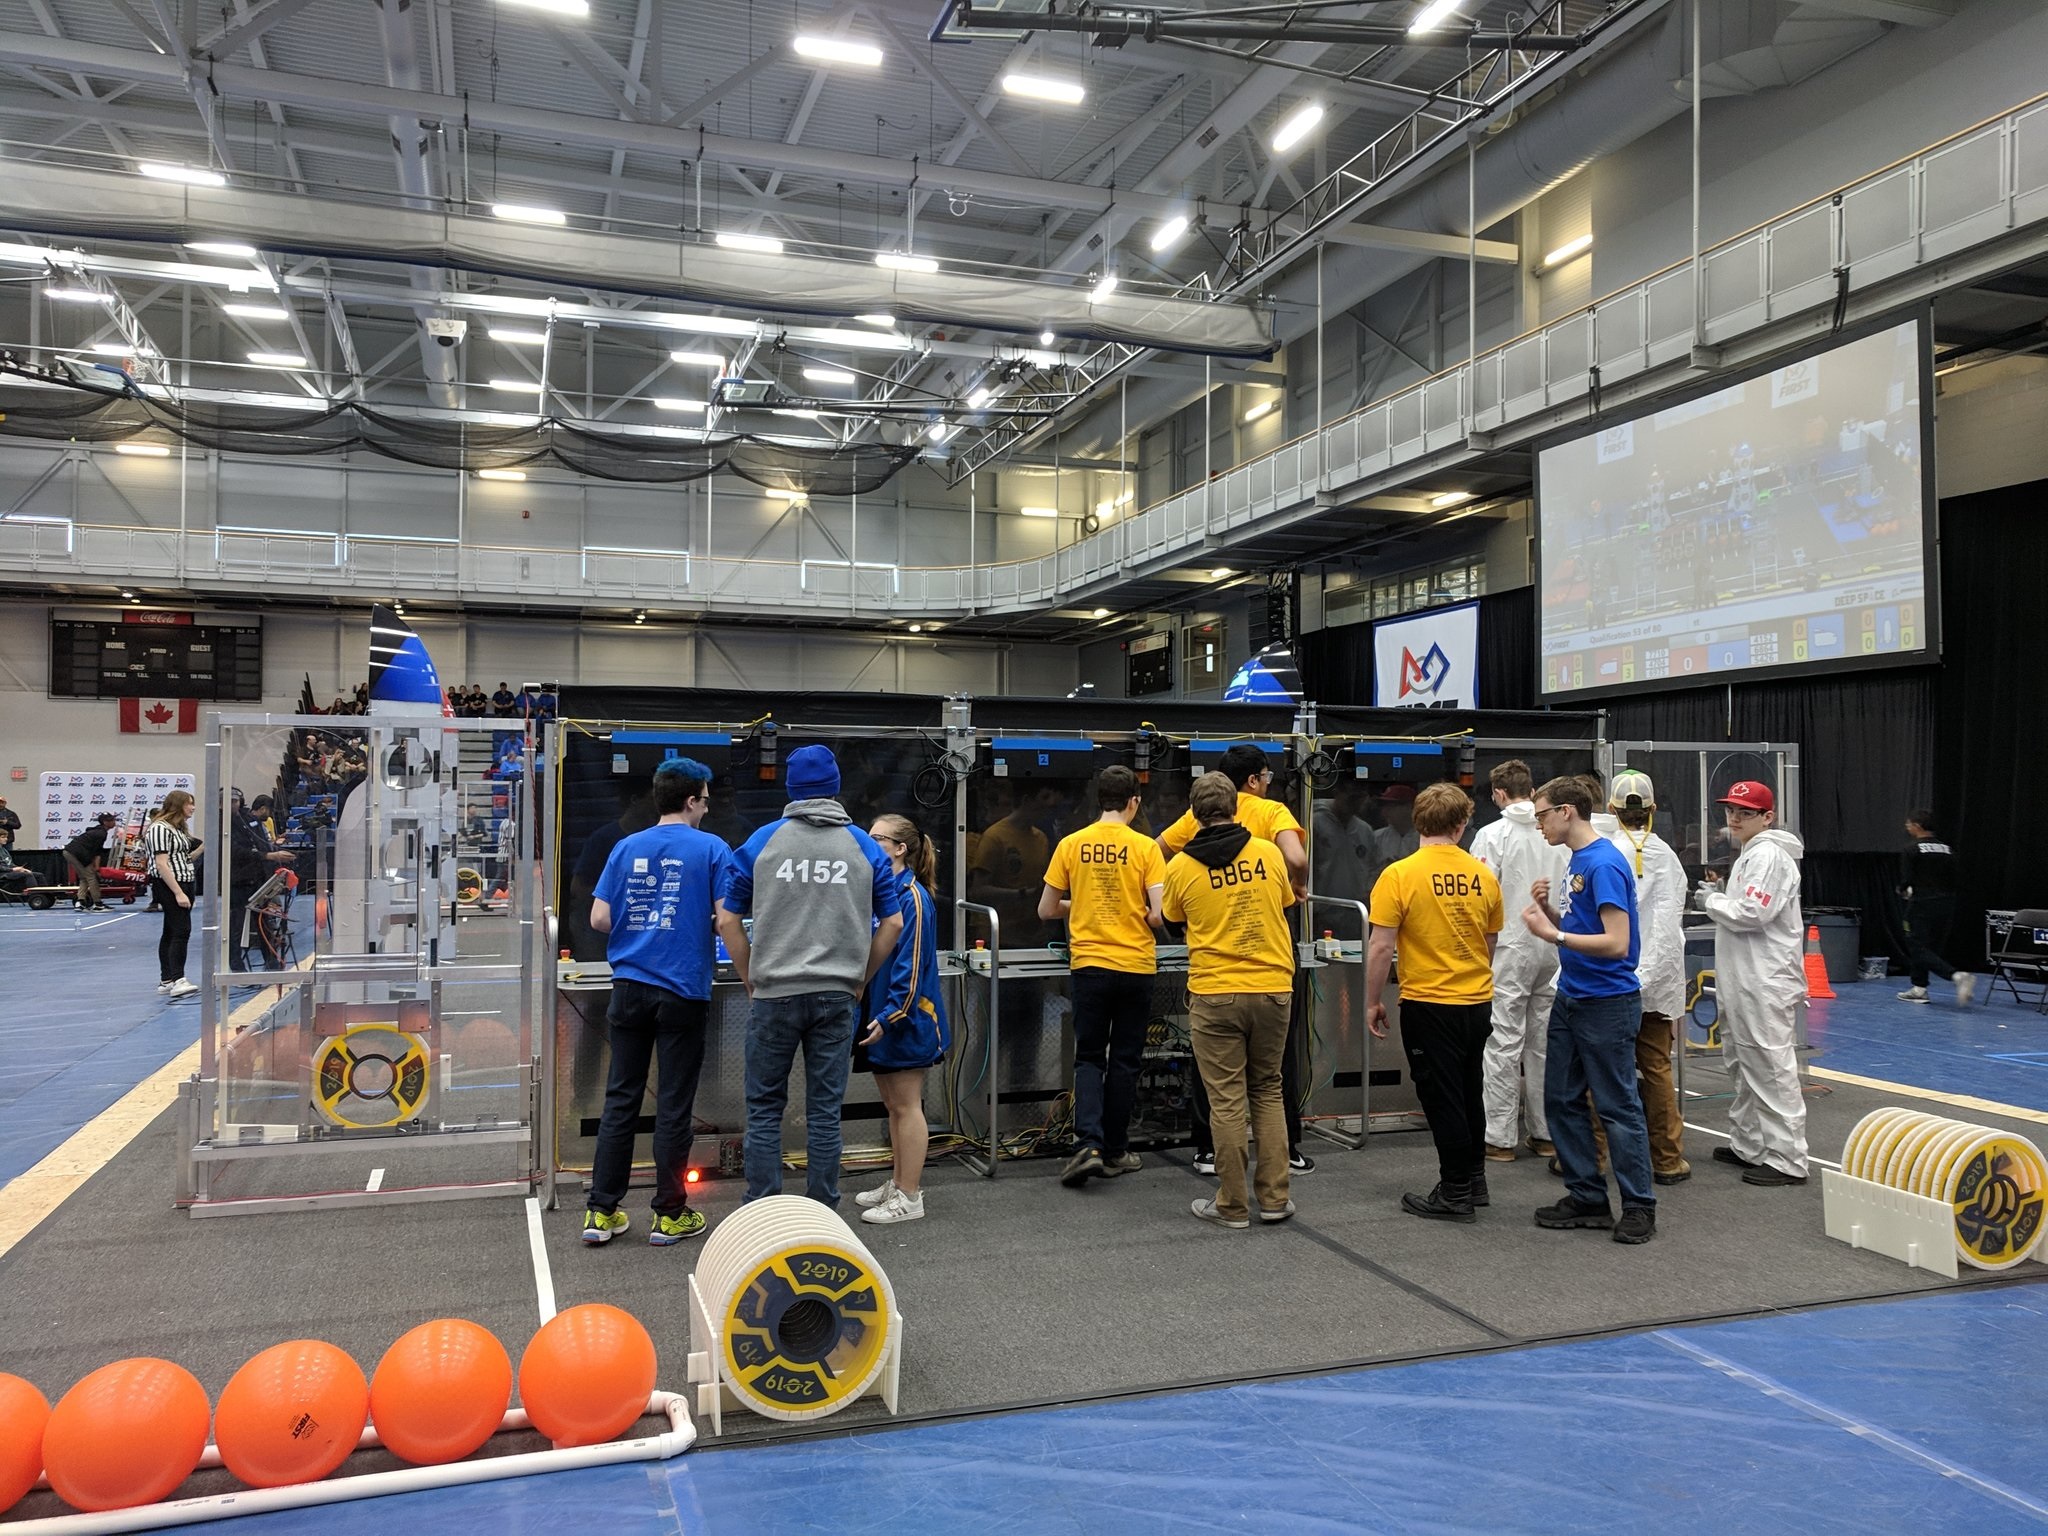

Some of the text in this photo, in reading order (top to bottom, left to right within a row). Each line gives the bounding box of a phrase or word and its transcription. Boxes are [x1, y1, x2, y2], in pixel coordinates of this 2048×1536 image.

[1779, 378, 1811, 398] FIRST
[105, 641, 126, 650] HOME
[1590, 630, 1631, 644] Qualification
[1866, 637, 1872, 649] 0
[1904, 633, 1911, 645] 0
[1724, 652, 1733, 666] 0
[1796, 645, 1803, 657] 0
[1684, 657, 1692, 671] 0
[1081, 844, 1128, 865] 6864
[125, 872, 146, 882] 7712
[776, 858, 849, 884] 4152
[1208, 858, 1267, 890] 6864
[1432, 874, 1482, 896] 6864
[326, 1058, 341, 1089] 2019
[405, 1066, 418, 1097] 2019
[1962, 1161, 1983, 1195] 2019
[2015, 1208, 2037, 1242] 2019
[800, 1260, 848, 1282] 2019
[765, 1374, 815, 1395] 2019
[292, 1413, 311, 1439] FIRST
